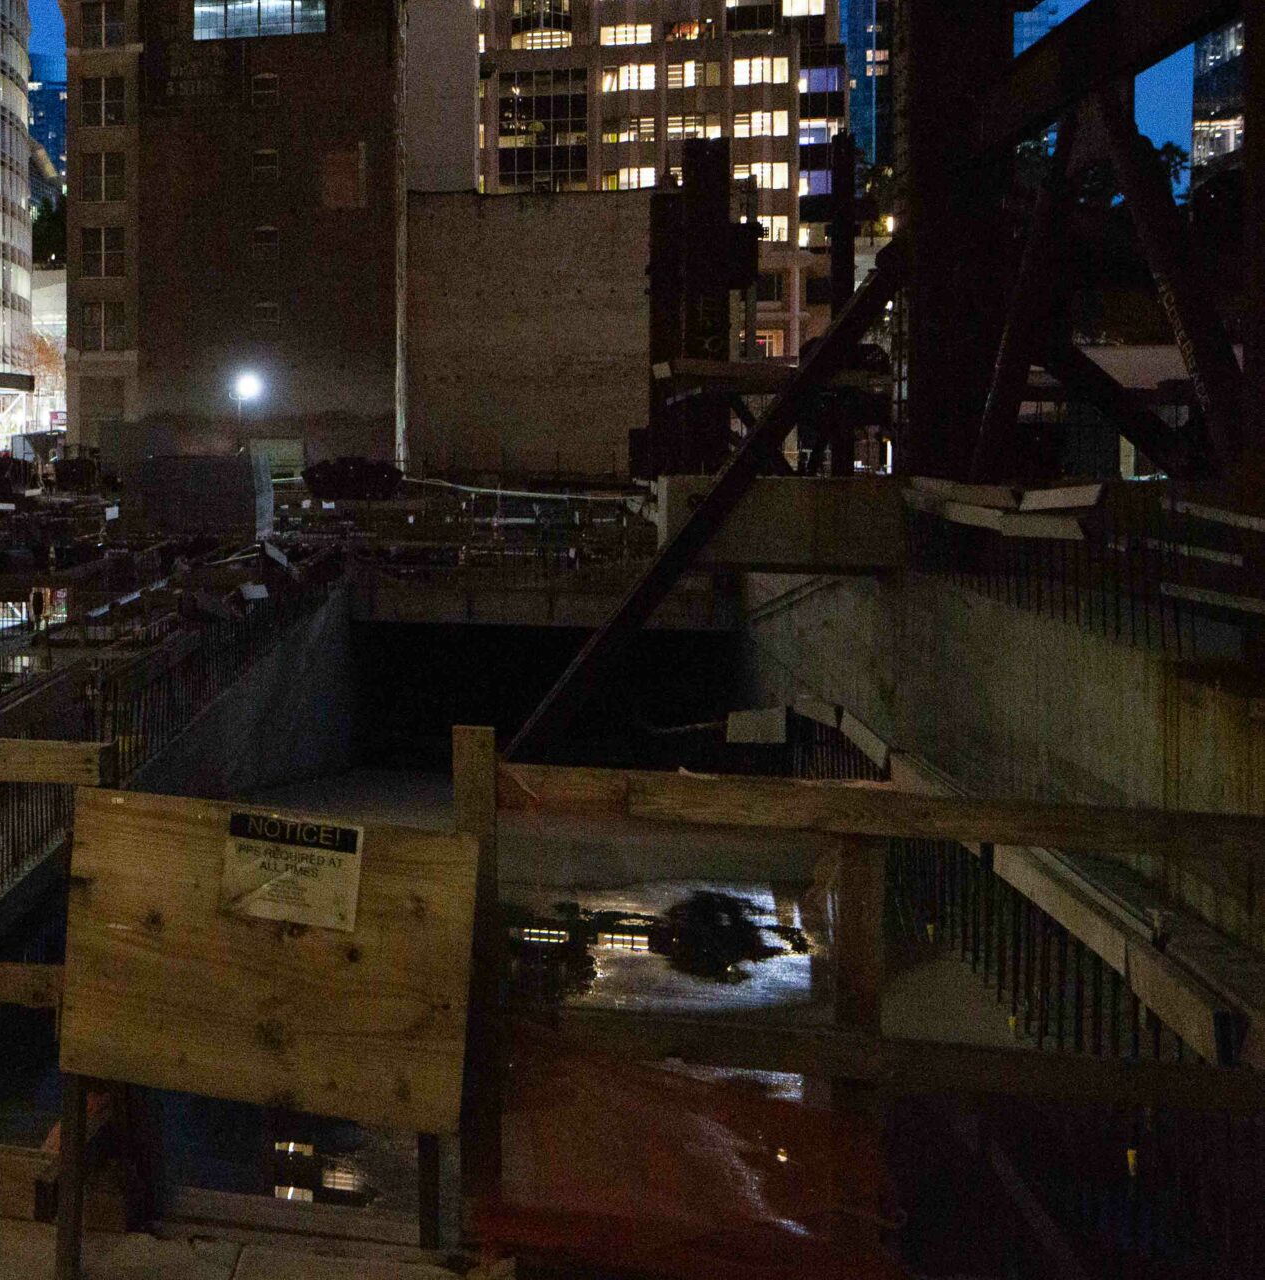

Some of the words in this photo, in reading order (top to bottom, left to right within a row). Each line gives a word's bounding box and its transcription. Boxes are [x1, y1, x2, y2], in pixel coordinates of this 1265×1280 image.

[247, 816, 341, 847] NOTICE!
[259, 861, 280, 873] ALL
[264, 846, 325, 866] REQUIRED
[328, 858, 344, 869] AT
